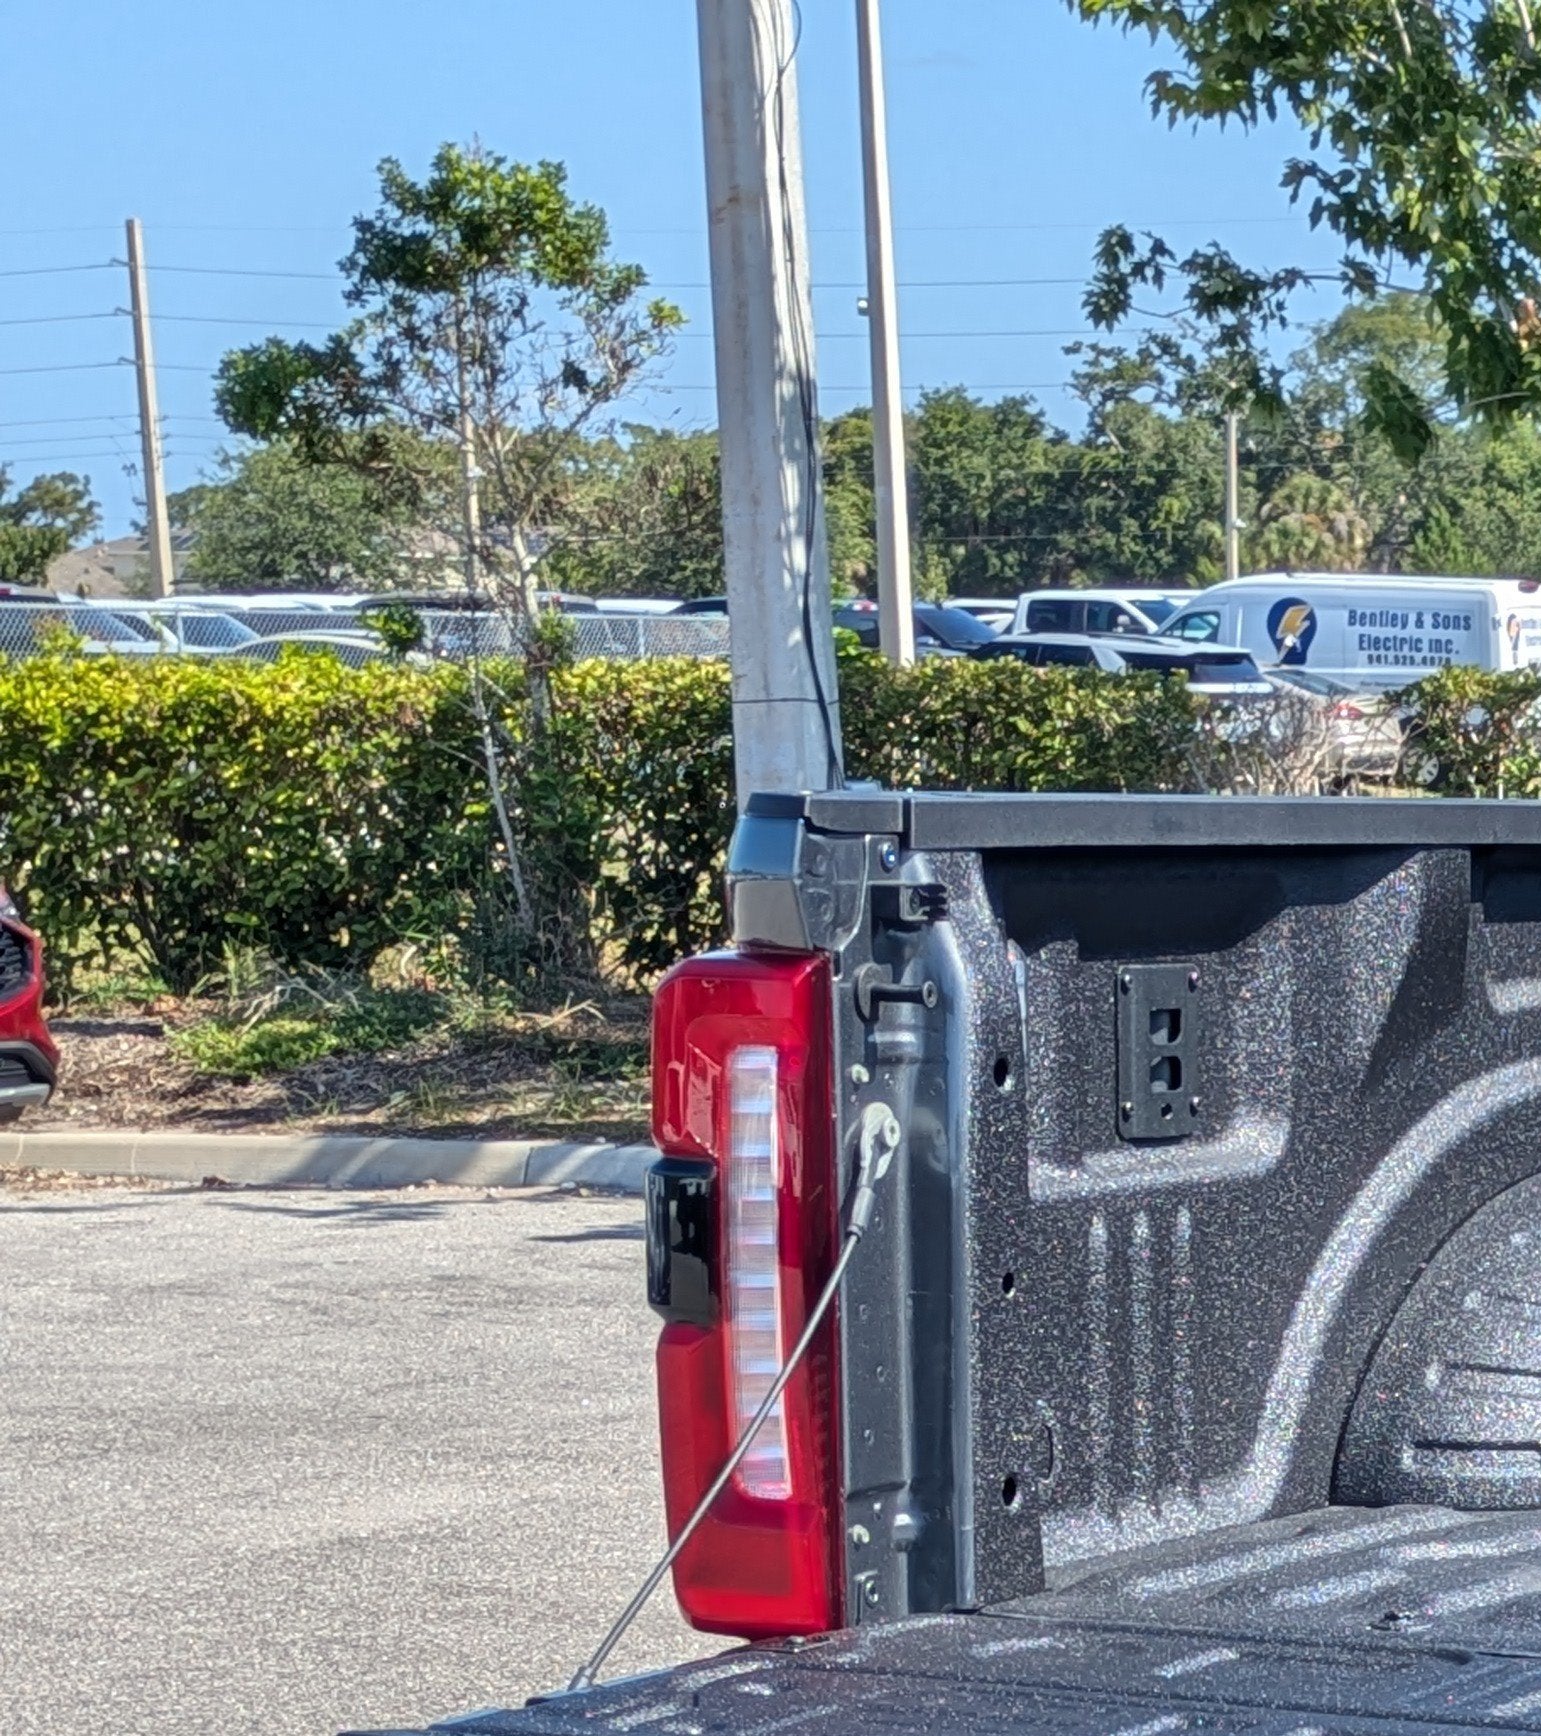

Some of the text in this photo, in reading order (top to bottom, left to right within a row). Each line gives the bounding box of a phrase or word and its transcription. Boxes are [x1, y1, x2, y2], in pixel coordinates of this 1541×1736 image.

[1347, 608, 1472, 631] Bentley & Sons
[1358, 633, 1424, 653] Electric
